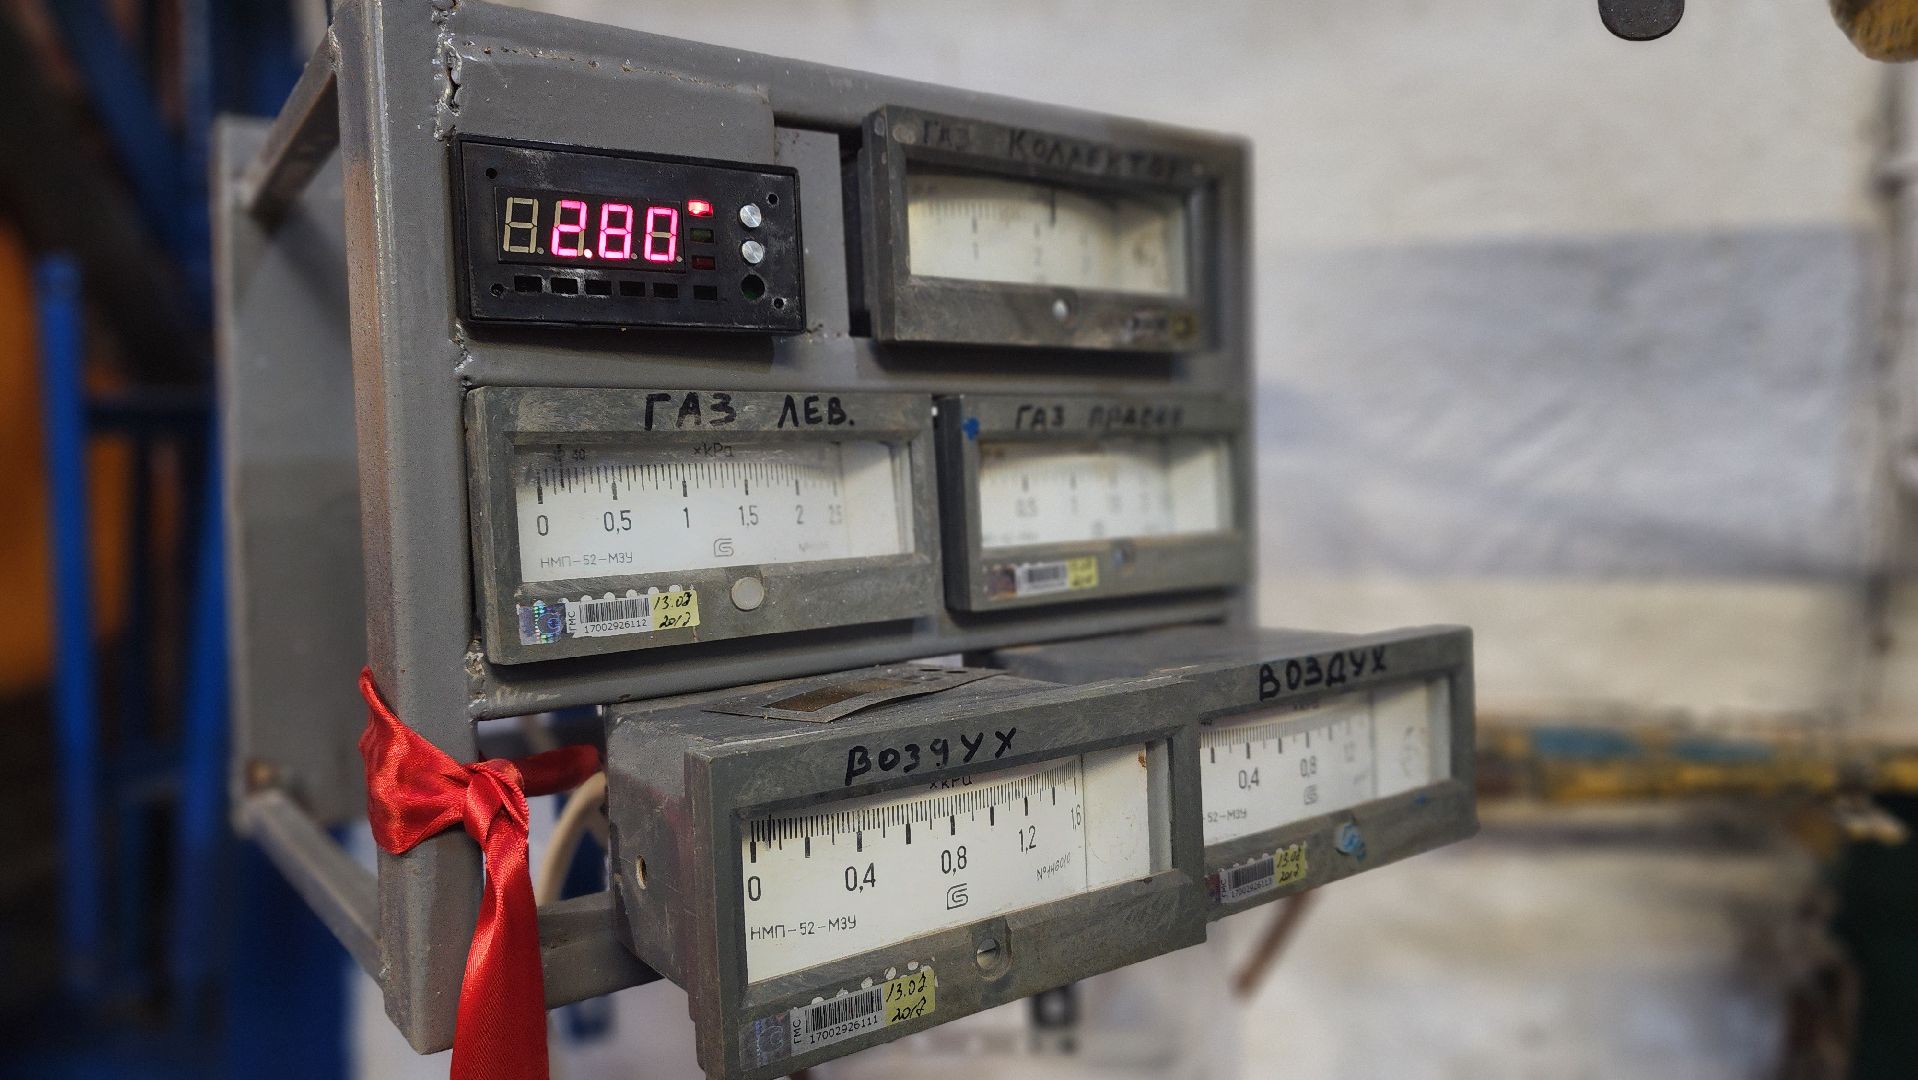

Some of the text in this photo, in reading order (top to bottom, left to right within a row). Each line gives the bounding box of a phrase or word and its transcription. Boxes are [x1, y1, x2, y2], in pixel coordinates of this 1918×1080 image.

[551, 199, 679, 263] 2.80
[644, 391, 855, 430] ГАЗ ЛЕВ.
[1015, 404, 1065, 432] ГАЗ
[535, 514, 549, 536] 0
[603, 509, 633, 535] 0,5
[682, 506, 691, 529] 1
[738, 504, 760, 527] 1,5
[795, 504, 804, 525] 2
[584, 618, 648, 634] 17002926112
[1259, 646, 1387, 701] ВОЗДУХ
[1238, 767, 1260, 792] 0,4
[1300, 755, 1318, 778] 0,8
[747, 804, 1082, 902] 0 0,4 0,8 1,2 1,6
[810, 1014, 879, 1045] 17002926111
